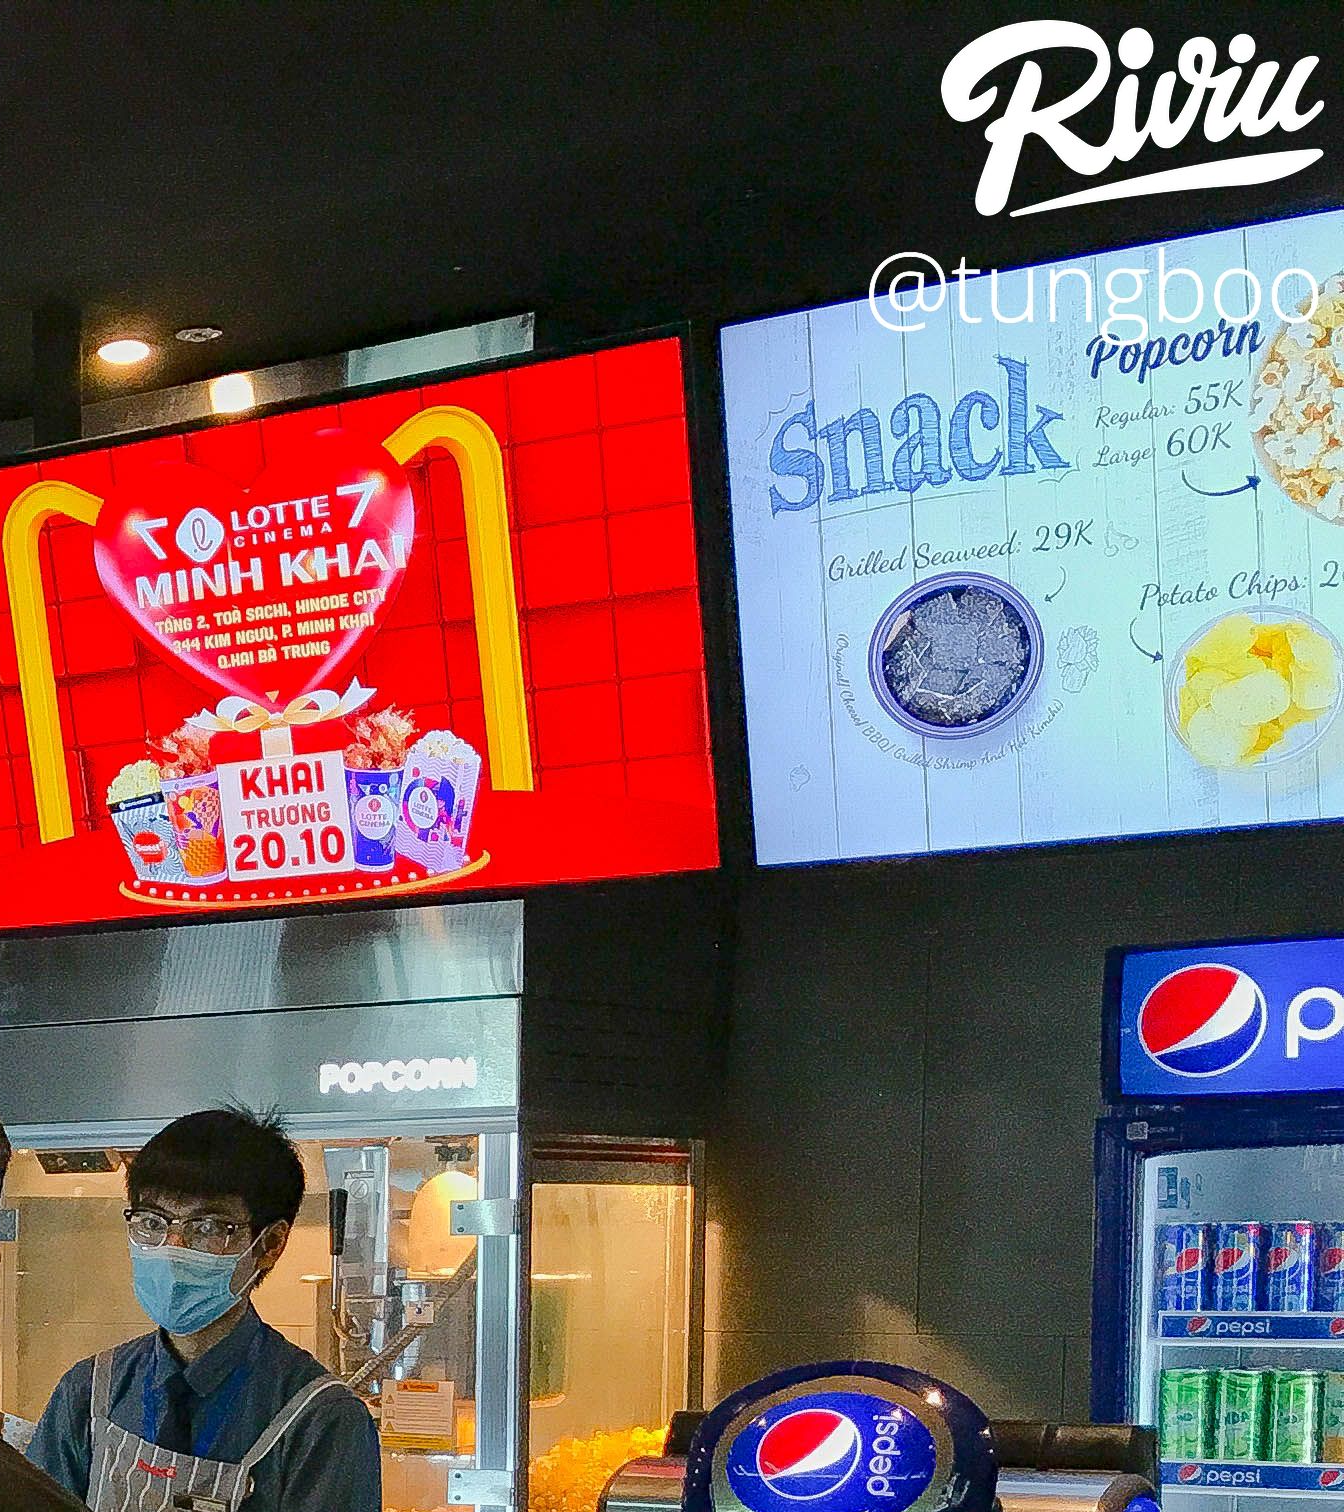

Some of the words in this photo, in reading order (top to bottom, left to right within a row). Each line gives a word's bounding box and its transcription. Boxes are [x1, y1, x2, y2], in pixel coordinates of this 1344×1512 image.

[1086, 318, 1264, 384] Popcorn
[1095, 398, 1176, 429] Regular:
[1184, 379, 1243, 415] 55K
[1167, 421, 1232, 457] 60K
[229, 495, 330, 532] LOTTE
[233, 522, 332, 548] CINEMA
[828, 549, 909, 583] Grilled
[914, 534, 1022, 570] Seaweed:
[1032, 520, 1095, 552] 29K
[135, 557, 265, 609] MINH
[279, 533, 407, 587] KHAI
[1139, 579, 1218, 612] Potato
[1228, 566, 1310, 606] Chips:
[246, 602, 291, 623] SACHI,
[295, 592, 350, 615] HINODE
[353, 587, 387, 607] CITY
[172, 636, 201, 655] 344
[204, 631, 231, 650] KIM
[298, 617, 335, 636] MINH
[339, 612, 375, 631] KHAI
[258, 647, 277, 664] BÀ
[239, 761, 325, 801] KHAI
[234, 826, 347, 873] 20.10
[319, 1057, 477, 1094] POPCORN
[1216, 1319, 1272, 1336] pepsi
[866, 1413, 901, 1498] pepsi
[1206, 1467, 1262, 1486] pepsi
